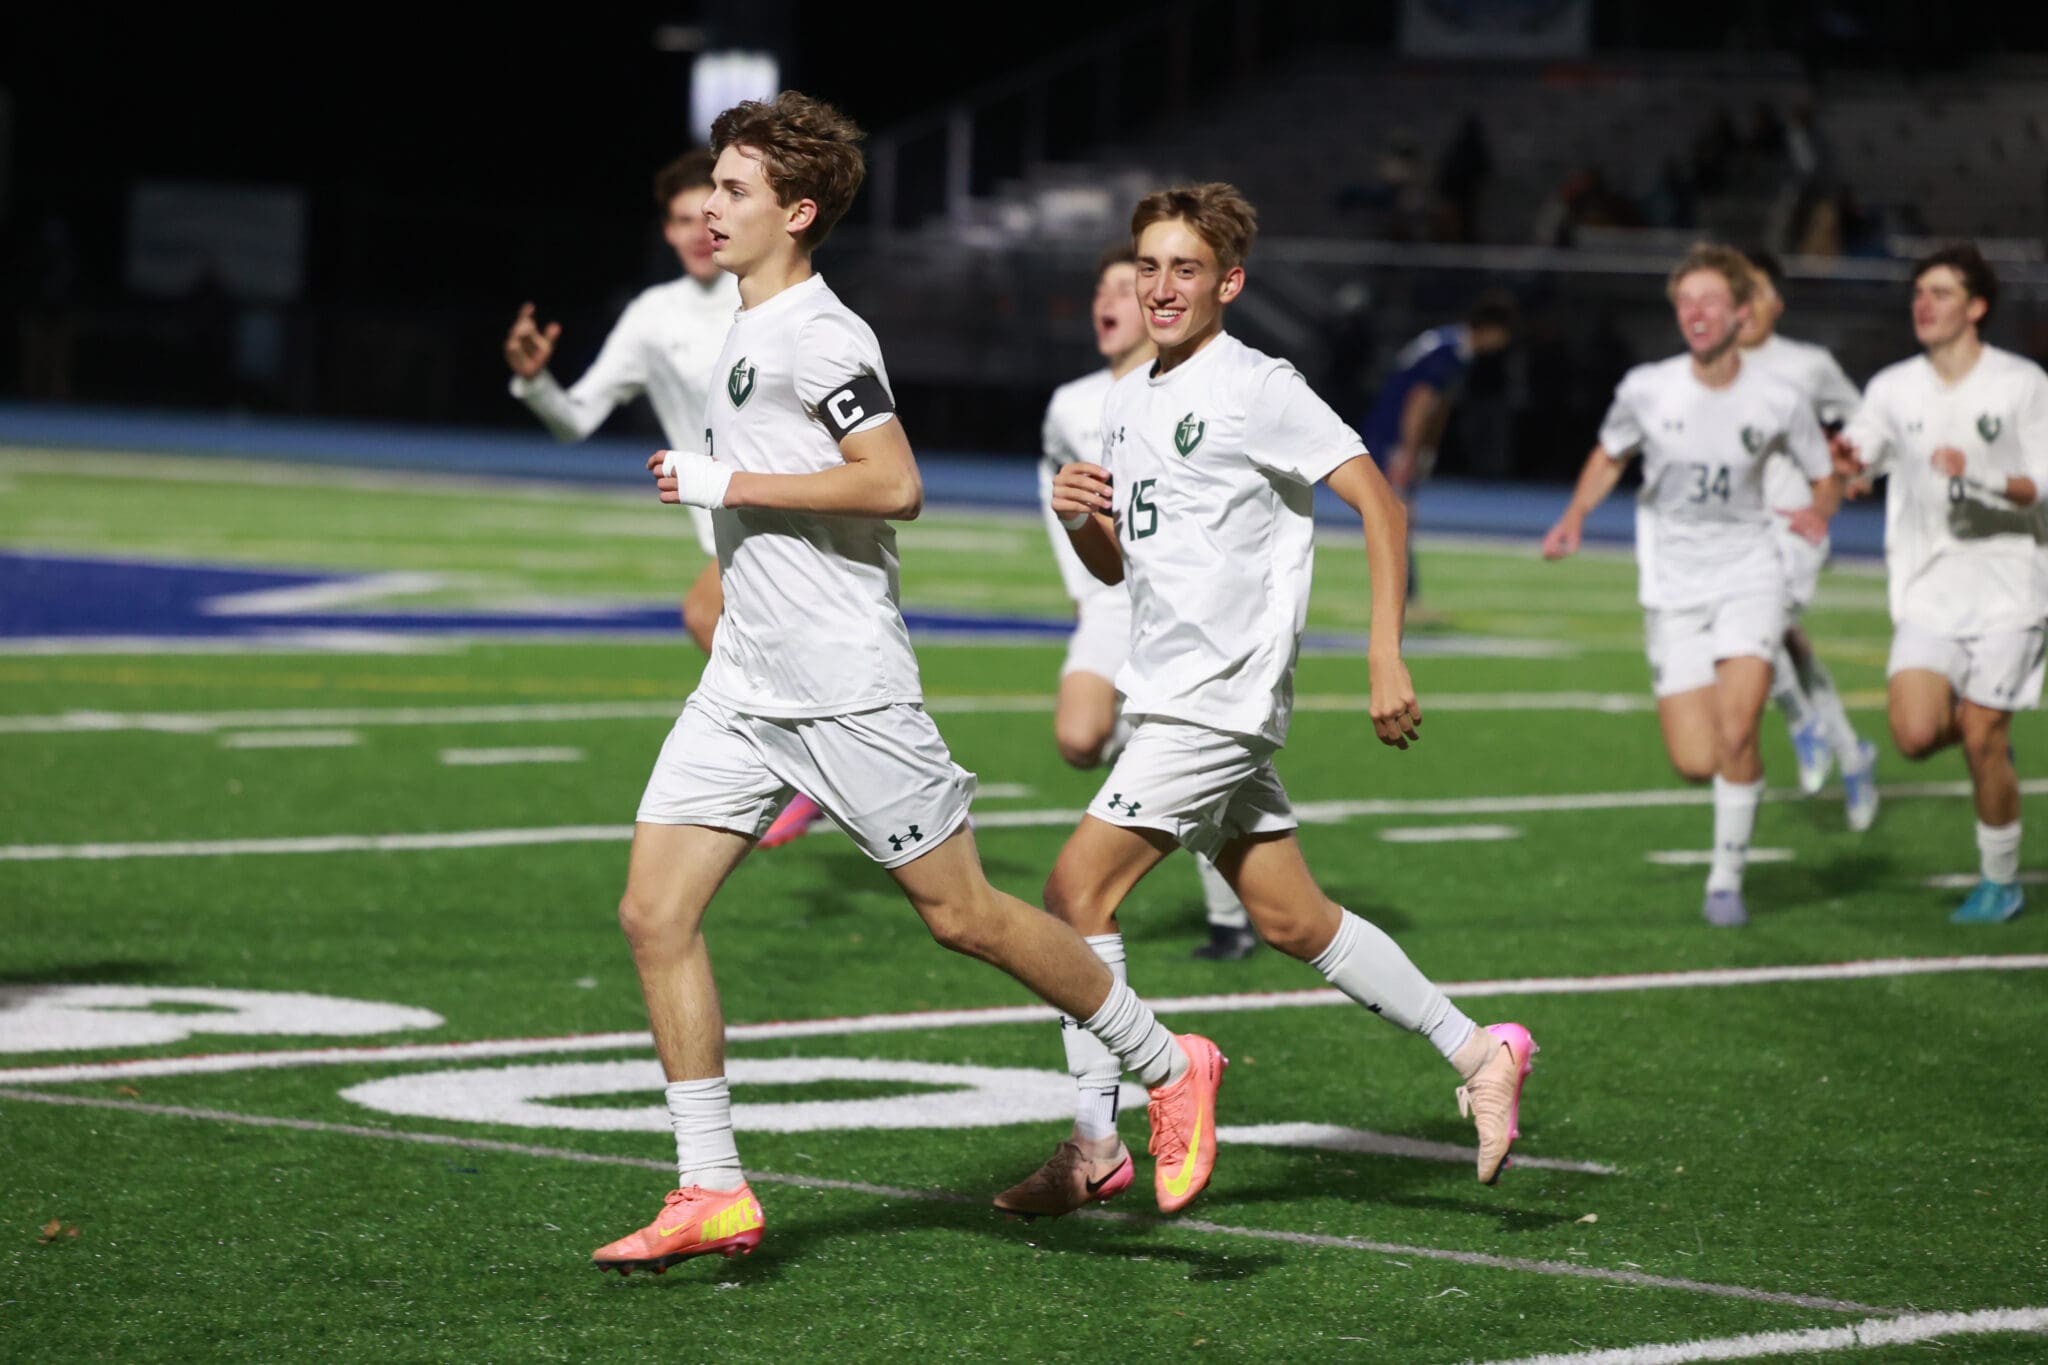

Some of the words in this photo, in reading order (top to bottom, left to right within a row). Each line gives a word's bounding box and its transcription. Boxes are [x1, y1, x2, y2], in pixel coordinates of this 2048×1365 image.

[827, 389, 864, 430] C
[1686, 463, 1730, 503] 34
[1128, 478, 1158, 541] 15
[701, 1197, 760, 1243] NIKE
